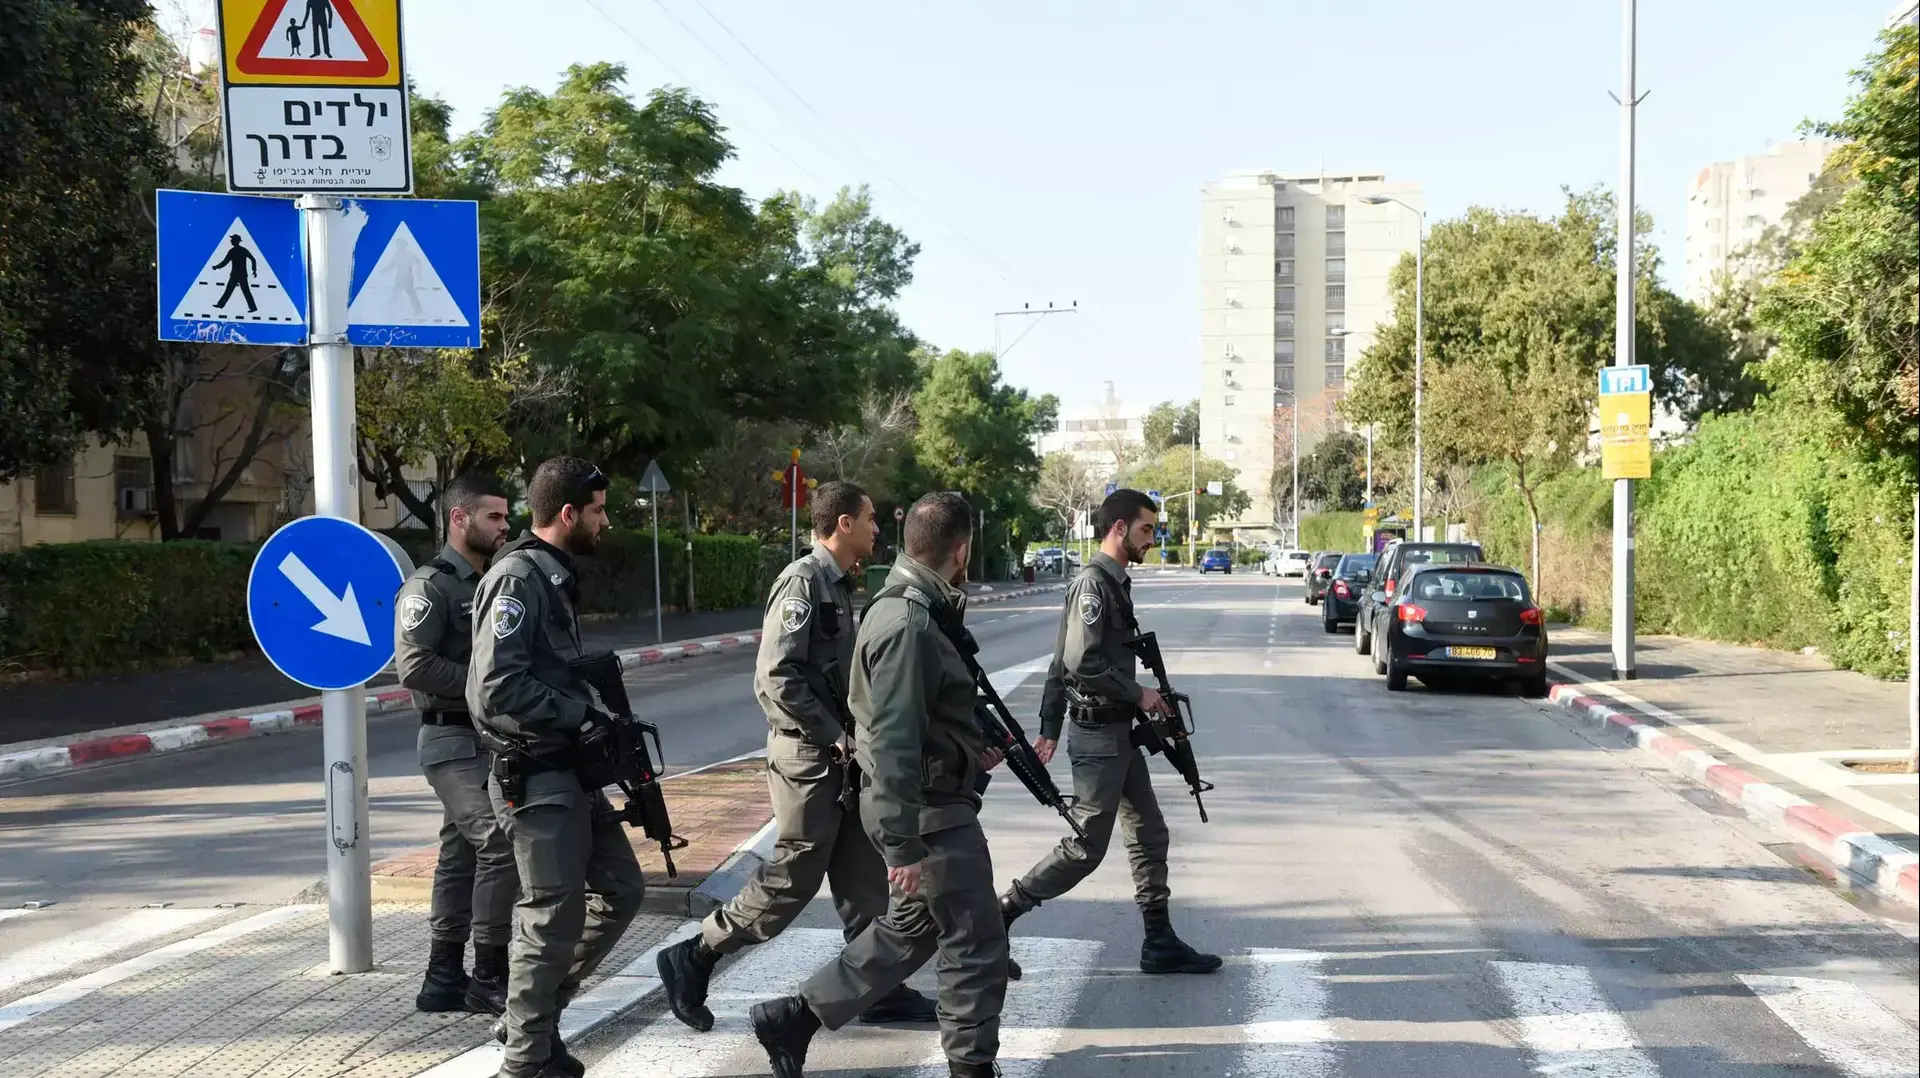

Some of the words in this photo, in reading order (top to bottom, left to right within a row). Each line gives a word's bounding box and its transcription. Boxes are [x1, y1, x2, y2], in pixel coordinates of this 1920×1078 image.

[283, 92, 388, 127] ילדים
[245, 133, 348, 167] בדרך
[340, 168, 371, 176] עיריית
